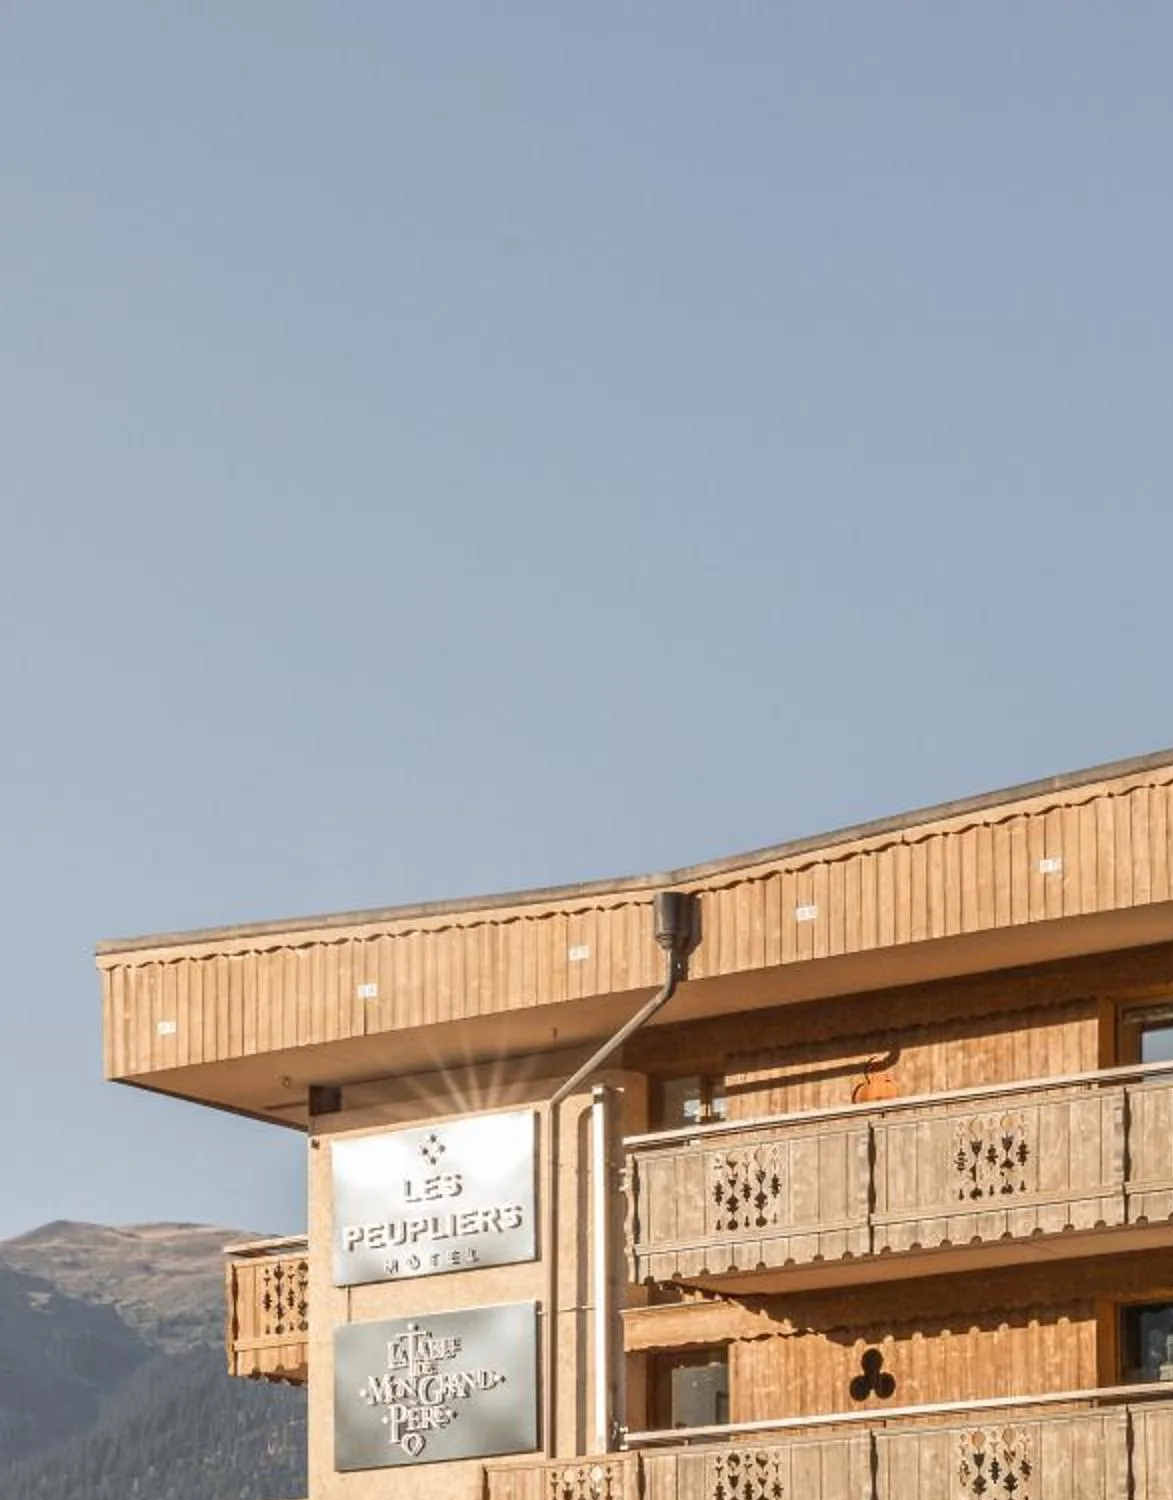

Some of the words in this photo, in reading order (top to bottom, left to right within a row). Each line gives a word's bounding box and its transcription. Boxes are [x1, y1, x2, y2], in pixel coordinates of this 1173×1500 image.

[402, 1172, 463, 1203] LES
[343, 1204, 523, 1252] PEUPLIERS
[367, 1374, 419, 1406] MON
[418, 1369, 499, 1406] GRAND
